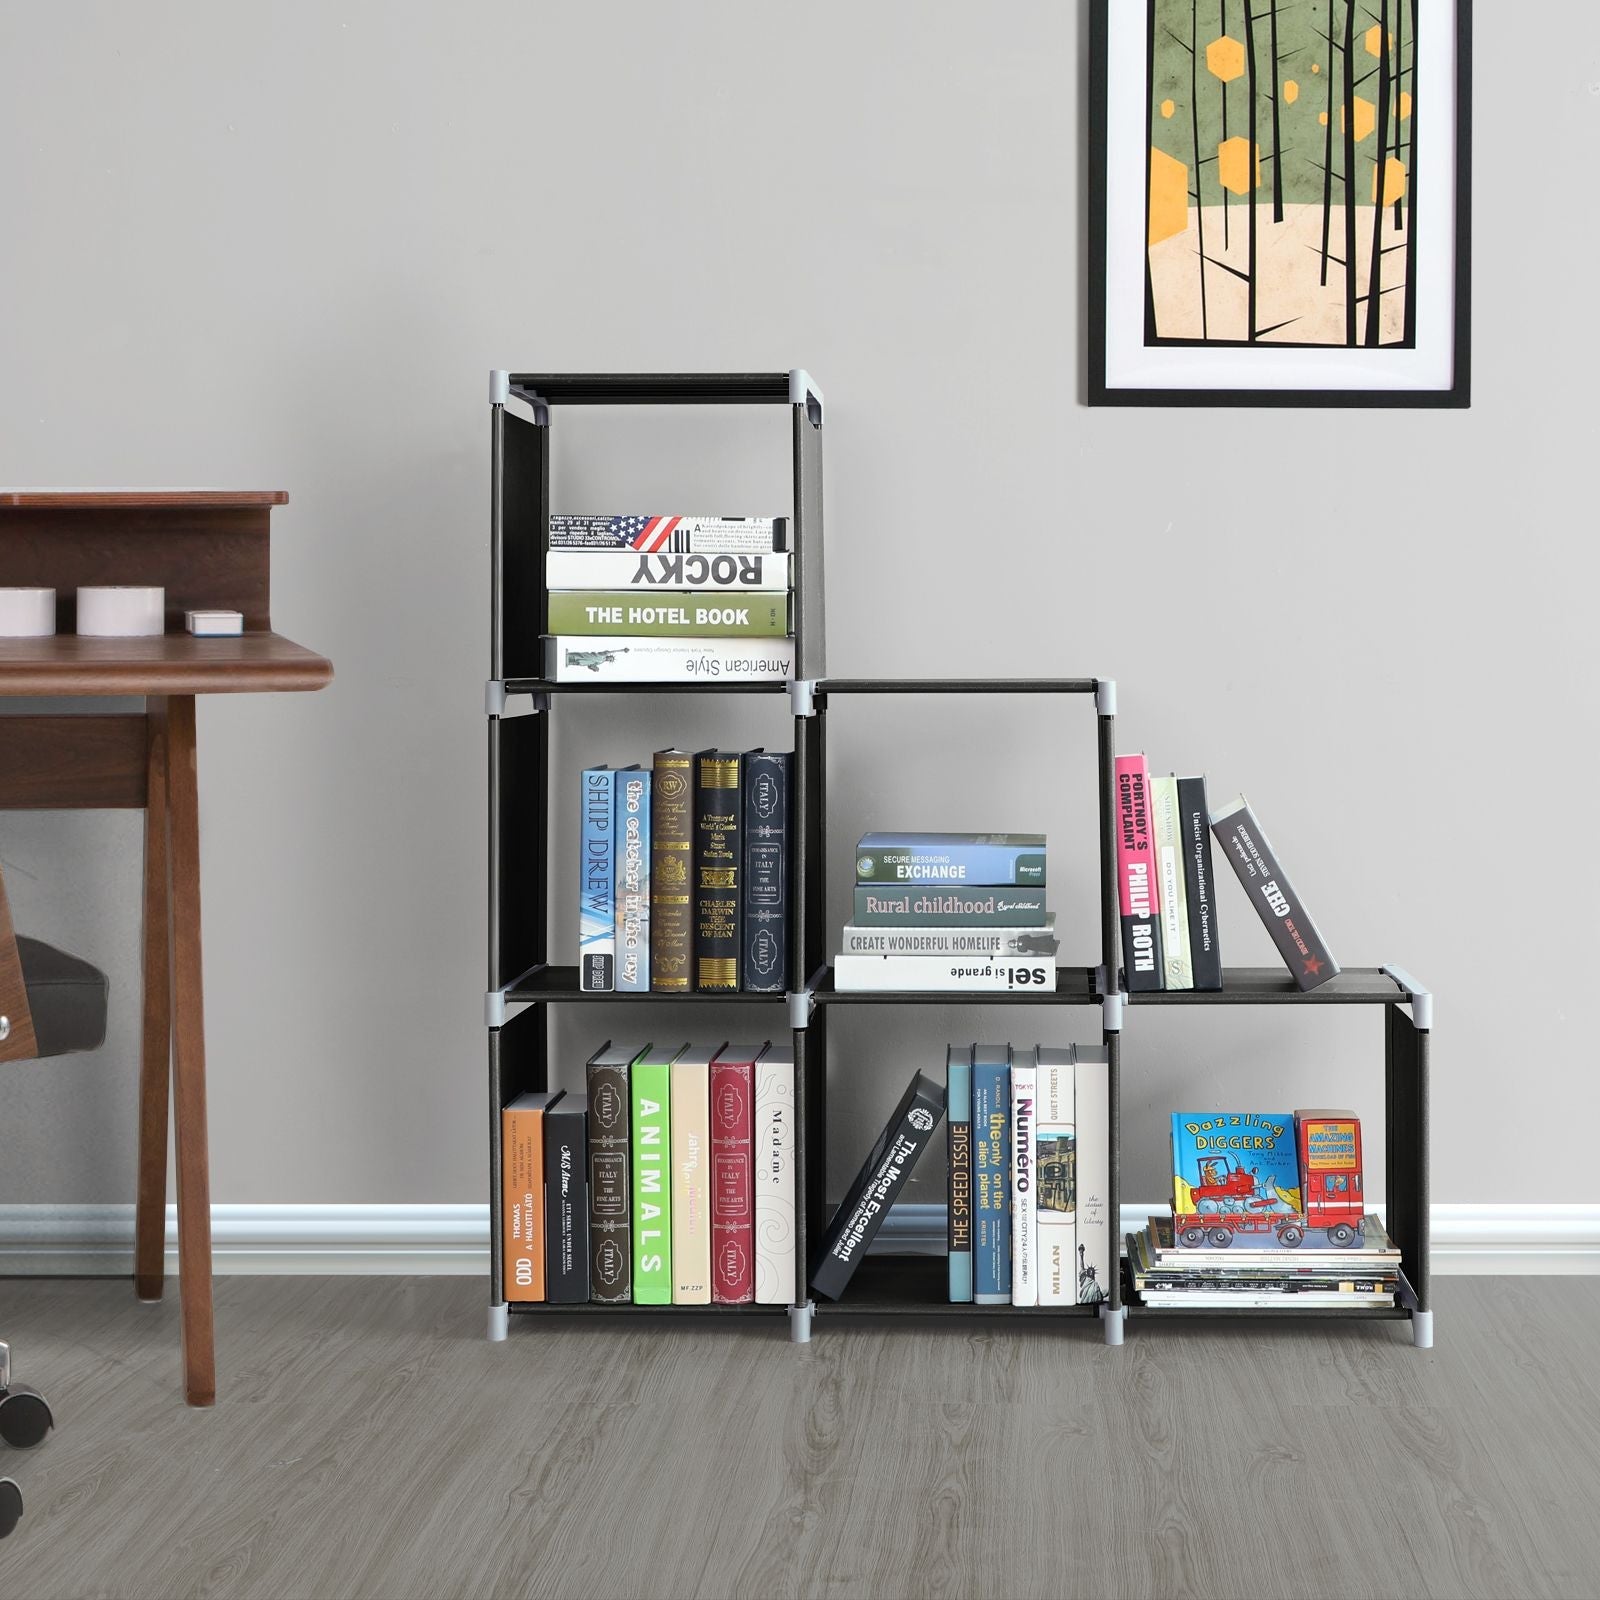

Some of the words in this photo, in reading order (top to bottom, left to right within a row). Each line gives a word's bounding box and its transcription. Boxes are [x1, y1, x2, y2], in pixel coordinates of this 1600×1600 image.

[694, 524, 700, 532] A
[630, 554, 762, 585] ROCKY
[585, 606, 622, 624] THE
[628, 607, 690, 624] HOTEL
[696, 608, 749, 625] BOOK
[686, 656, 720, 676] Style
[726, 659, 790, 676] American
[588, 775, 609, 831] SHIP
[626, 780, 643, 813] the
[760, 782, 769, 810] ITALY
[707, 814, 728, 823] Treasury
[1120, 774, 1136, 851] COMPLAINT
[1132, 773, 1148, 851] PORTNOY'S
[1193, 812, 1201, 841] Unicist
[626, 817, 642, 891] catcher
[883, 855, 910, 863] SECURE
[911, 856, 950, 864] MESSAGING
[588, 840, 608, 914] DREW
[896, 865, 966, 879] EXCHANGE
[1194, 842, 1208, 903] Organizational
[626, 895, 642, 912] in
[700, 900, 736, 908] CHARLES
[1127, 862, 1150, 919] PHILIP
[1166, 862, 1172, 875] DO
[1170, 923, 1176, 932] IT
[1260, 880, 1290, 917] CHE
[866, 896, 910, 914] Rural
[913, 896, 995, 914] childhood
[626, 919, 642, 948] the
[702, 930, 713, 938] OF
[714, 930, 733, 938] MAN
[1200, 904, 1211, 951] Cybernetics
[759, 938, 768, 967] ITALY
[850, 936, 885, 950] CREATE
[888, 936, 949, 950] WONDERFUL
[952, 936, 1001, 951] HOMELIFE
[1132, 924, 1154, 972] ROTH
[950, 966, 992, 979] grande
[995, 968, 1006, 979] si
[1008, 967, 1046, 989] sei
[1050, 1068, 1058, 1100] STREETS
[602, 1092, 612, 1121] ITALY
[725, 1093, 734, 1121] ITALY
[1050, 1100, 1058, 1120] QUIET
[896, 1134, 905, 1146] and
[990, 1112, 1005, 1140] the
[1185, 1114, 1285, 1138] Dazzling
[1309, 1132, 1354, 1142] AMAZING
[772, 1110, 782, 1184] Madame
[894, 1140, 917, 1165] The
[953, 1125, 968, 1168] ISSUE
[978, 1140, 989, 1168] alien
[990, 1140, 1002, 1166] only
[1017, 1099, 1033, 1193] Numéro
[1196, 1136, 1276, 1150] DIGGERS
[1309, 1144, 1354, 1153] MACHINES
[877, 1145, 899, 1178] Lamentable
[640, 1098, 661, 1272] ANIMALS
[863, 1179, 881, 1202] Tragedy
[874, 1166, 901, 1200] Most
[953, 1172, 968, 1216] SPEED
[978, 1173, 990, 1210] planet
[994, 1173, 1002, 1189] on
[860, 1201, 867, 1210] of
[994, 1190, 1004, 1210] the
[839, 1200, 881, 1262] Excellent
[848, 1207, 864, 1228] Romeo
[842, 1228, 851, 1240] and
[953, 1219, 968, 1247] THE
[832, 1239, 845, 1256] Juliet
[516, 1258, 532, 1286] ODD
[604, 1249, 614, 1278] ITALY
[726, 1250, 736, 1278] ITALY
[1052, 1245, 1060, 1295] MILAN
